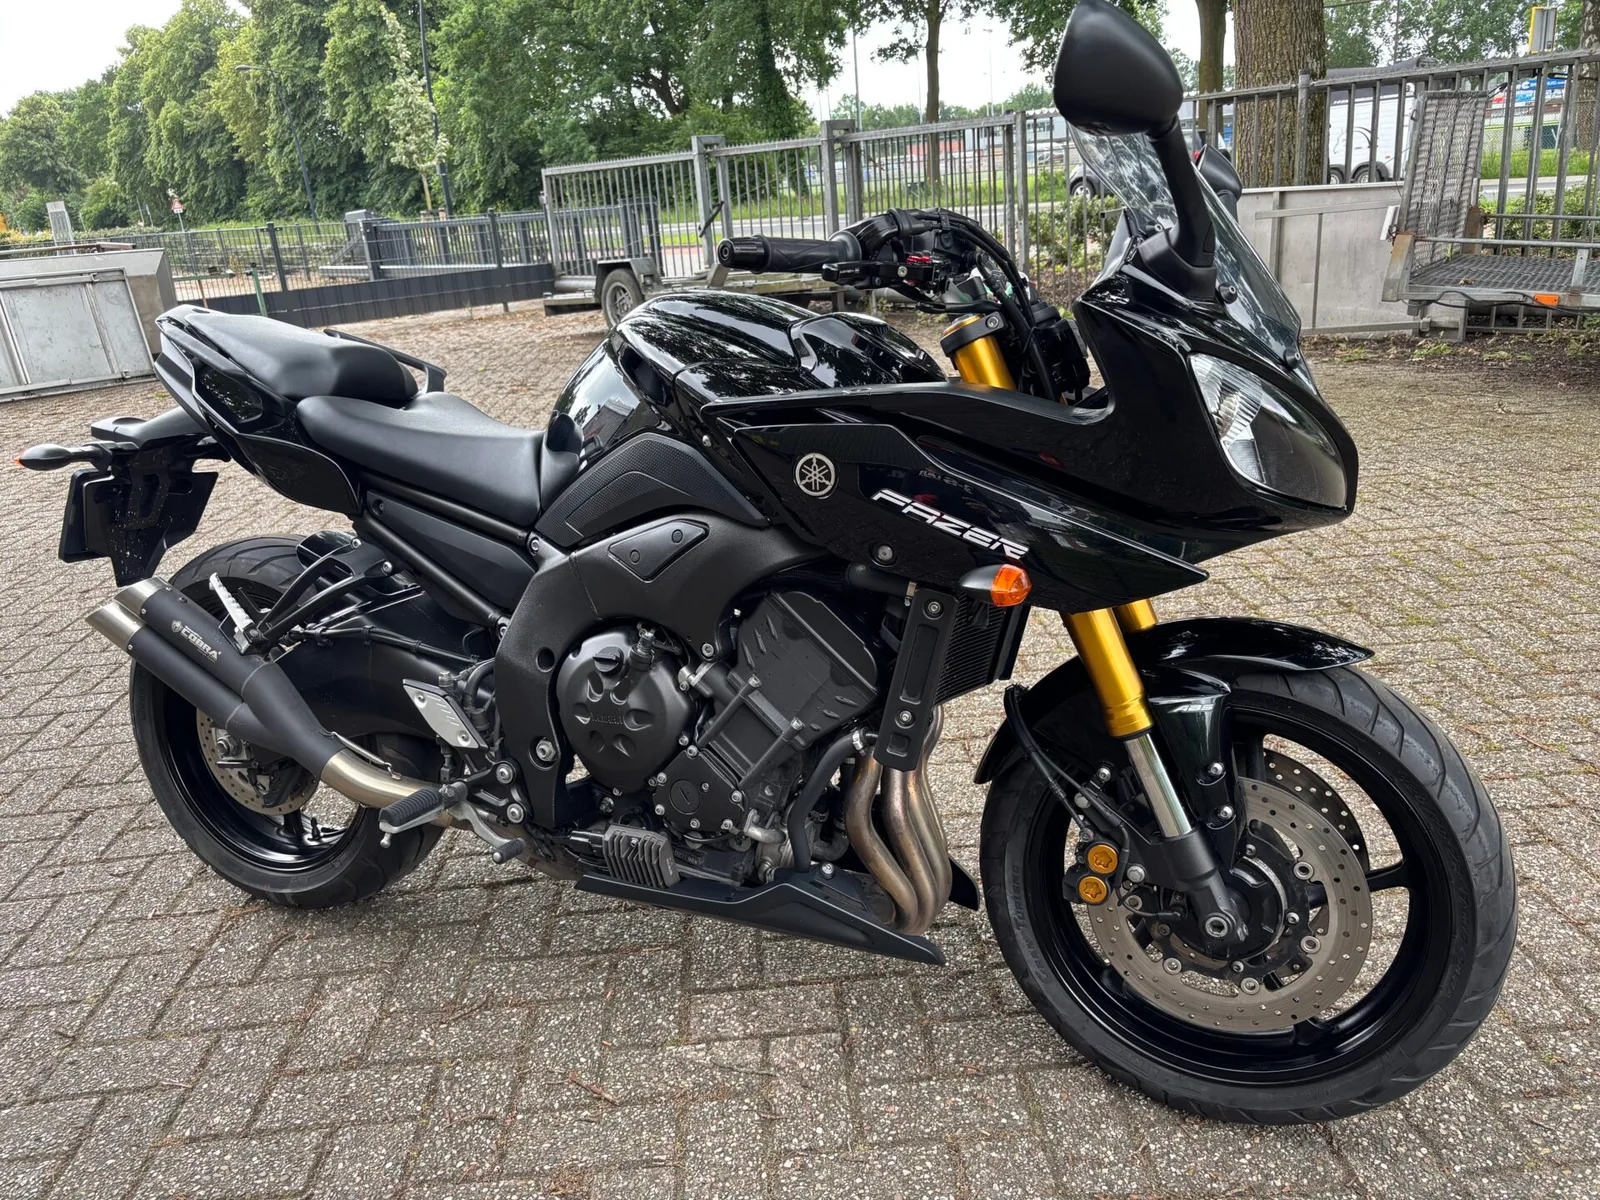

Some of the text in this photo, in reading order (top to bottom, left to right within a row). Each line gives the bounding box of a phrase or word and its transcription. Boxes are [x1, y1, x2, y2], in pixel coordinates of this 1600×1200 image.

[871, 488, 1029, 560] FAZER
[180, 627, 218, 660] COBRA
[1167, 703, 1215, 714] ABS
